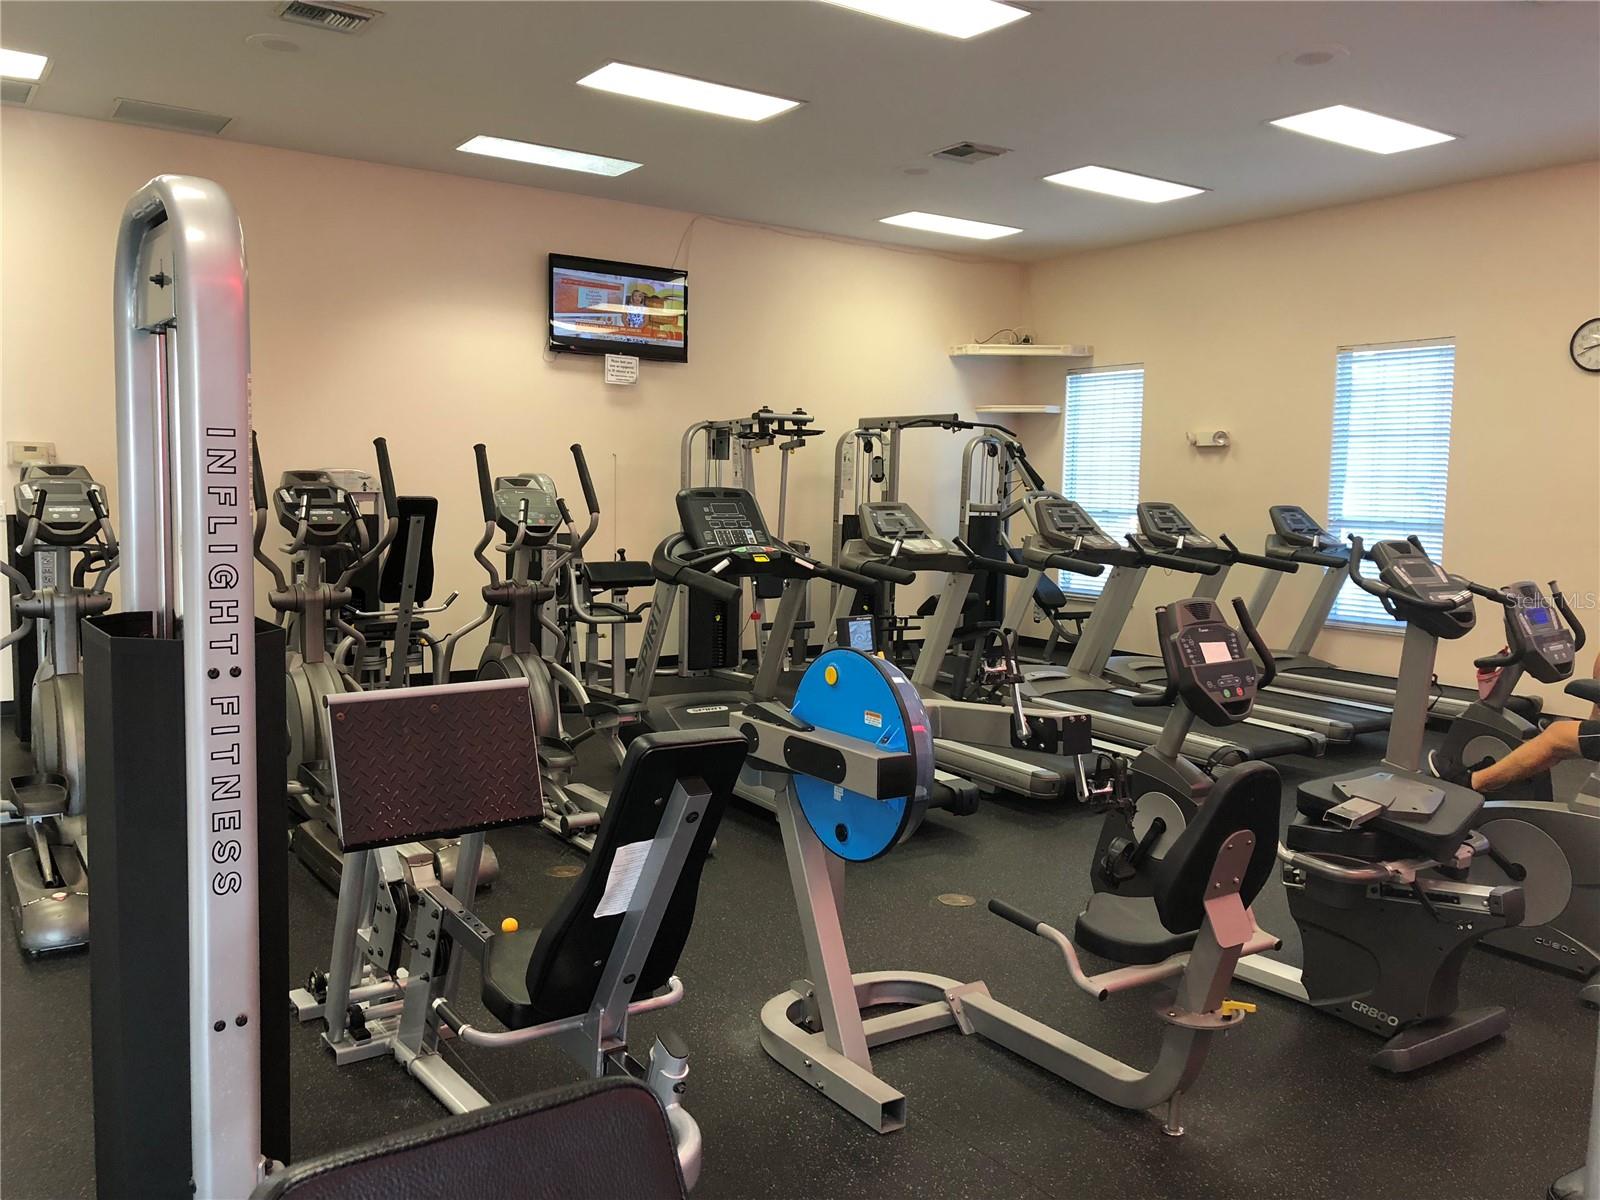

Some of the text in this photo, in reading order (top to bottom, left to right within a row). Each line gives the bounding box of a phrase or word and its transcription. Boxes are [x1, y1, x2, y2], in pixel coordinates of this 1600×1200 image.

[206, 427, 242, 896] INFLIGHT FITNESS
[1350, 1000, 1399, 1027] CR800
